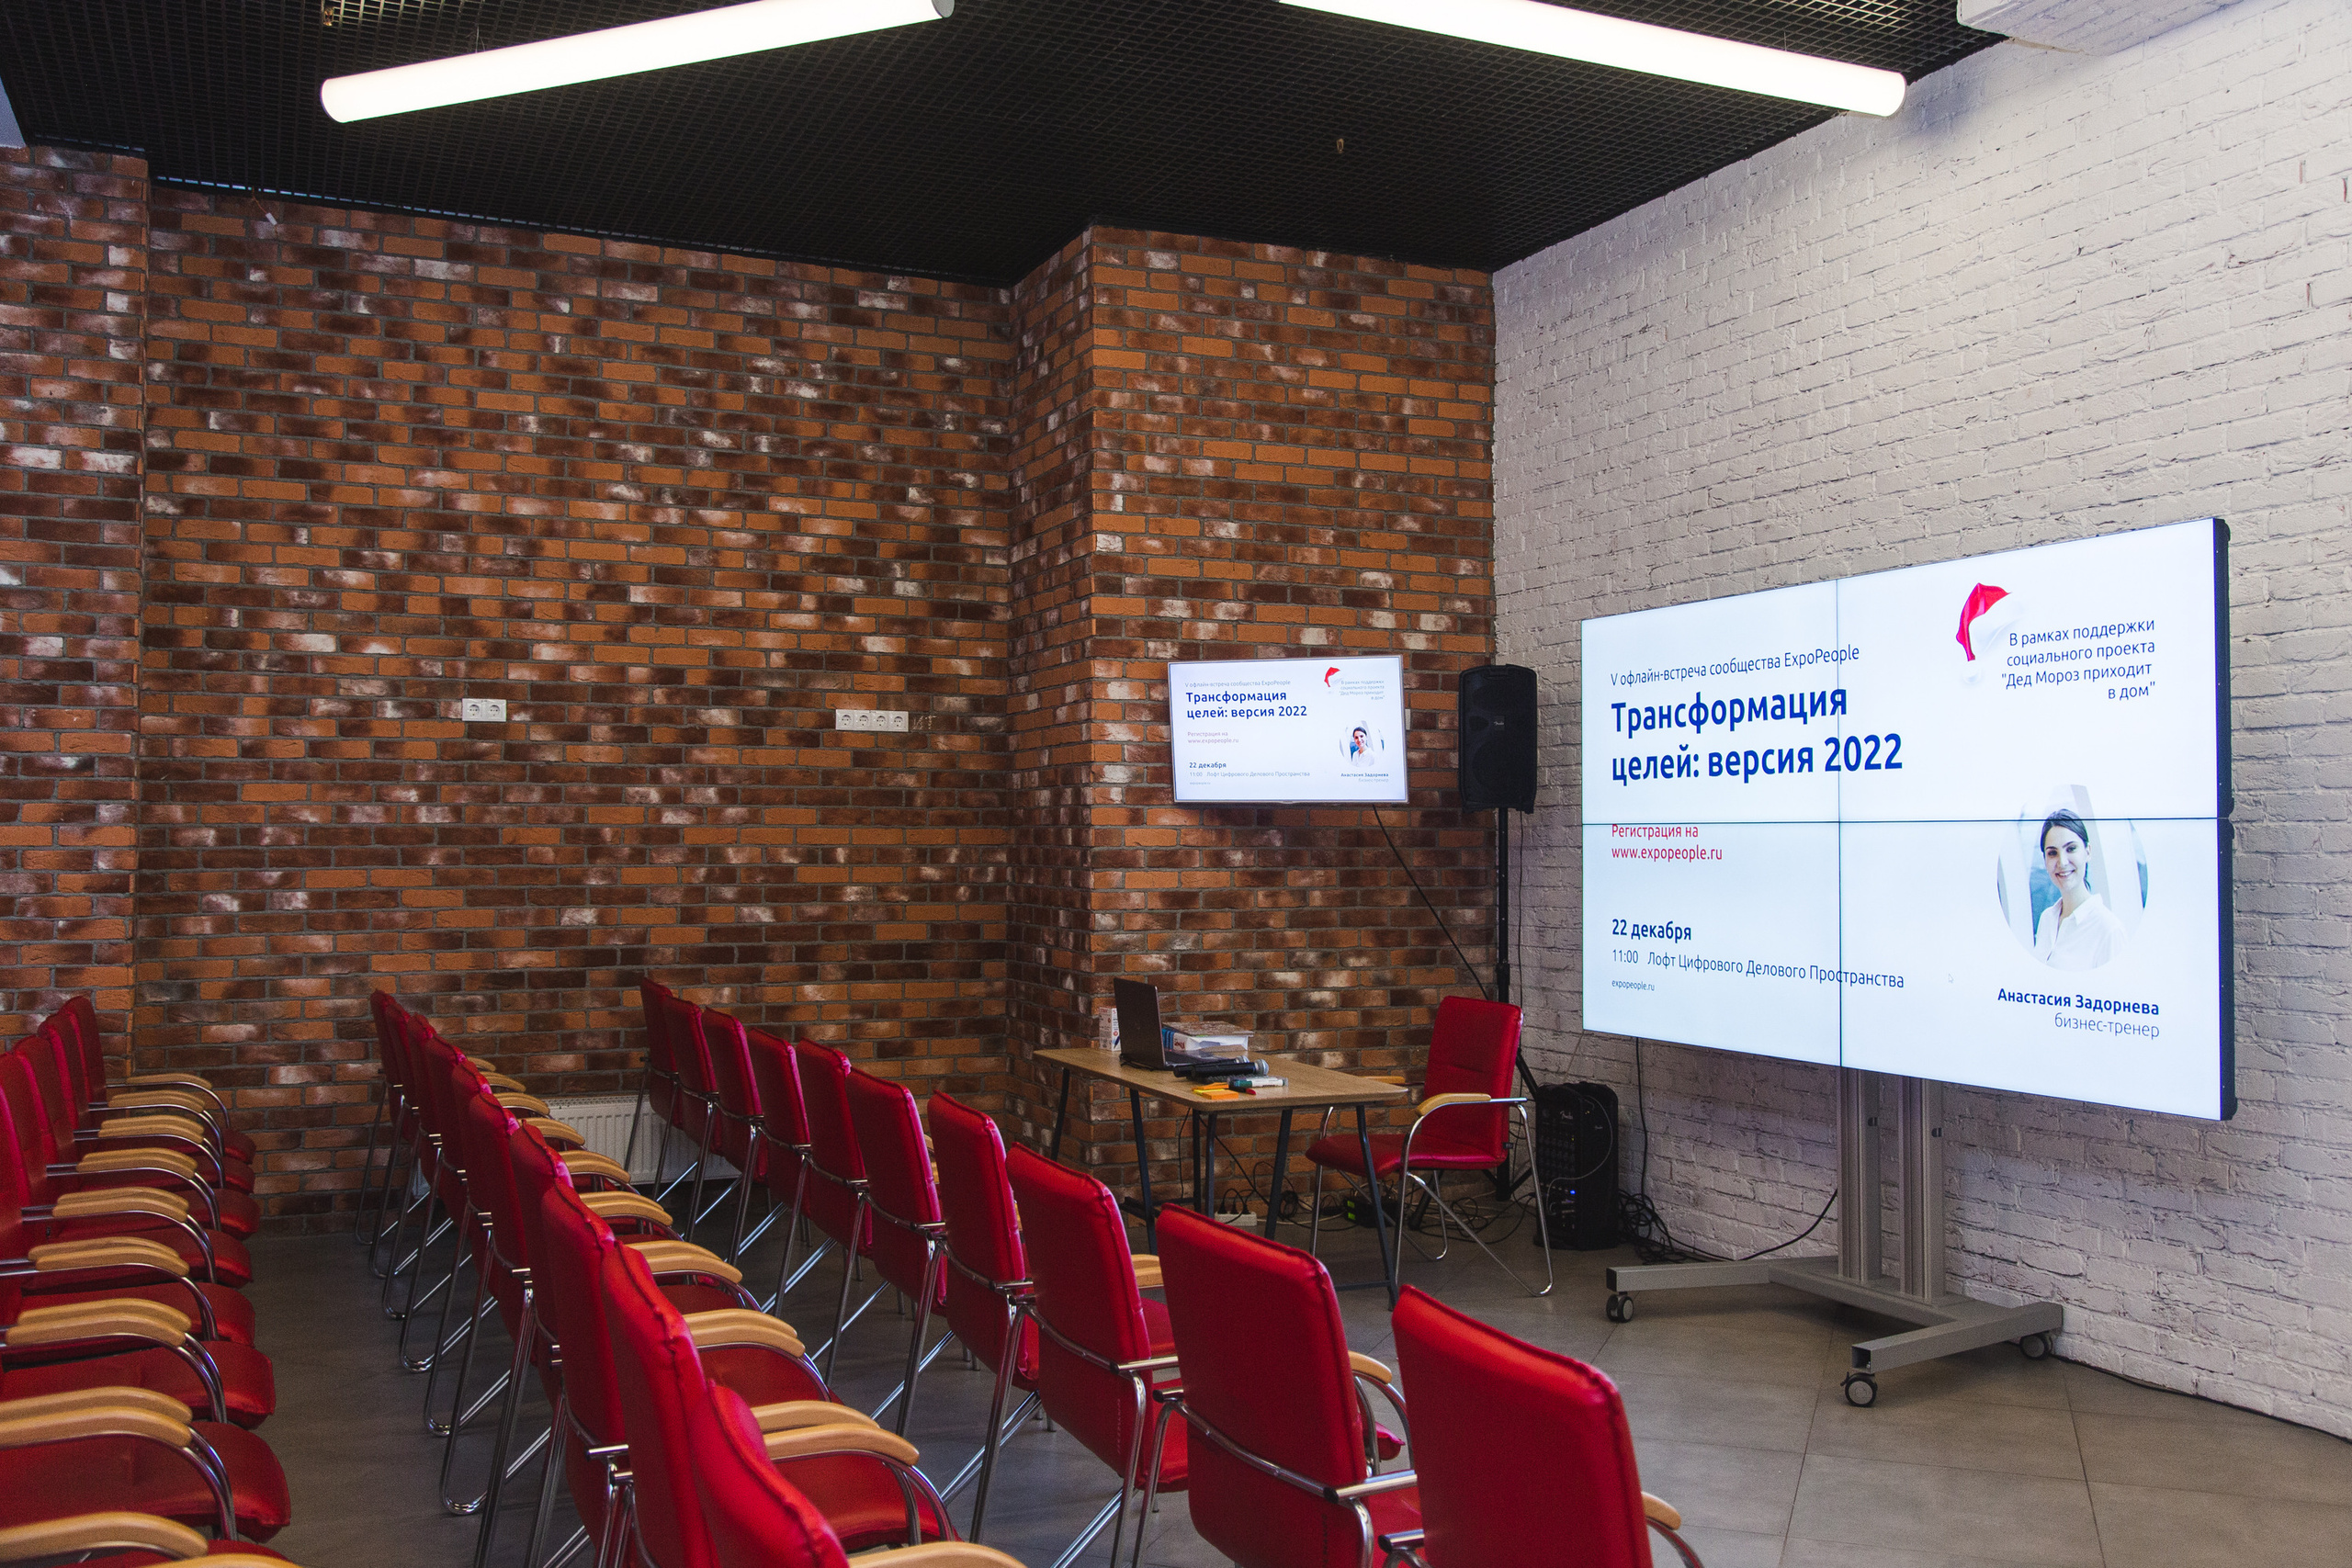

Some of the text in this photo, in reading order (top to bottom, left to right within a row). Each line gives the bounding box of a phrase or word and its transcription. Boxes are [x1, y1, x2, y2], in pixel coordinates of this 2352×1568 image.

[2009, 619, 2155, 649] В рамках поддержки
[1611, 644, 1860, 687] V офлайн-встреча сообщества ExpoPeople
[2007, 641, 2155, 667] социального проекта
[2001, 662, 2153, 690] "Дед Мороз приходит
[1185, 690, 1287, 705] Трансформация
[2108, 682, 2156, 701] в дом"
[1187, 705, 1307, 720] целей: версия 2022
[1611, 688, 1848, 739] Трансформация
[1198, 761, 1227, 770] декабря
[1611, 733, 1903, 787] целей: версия 2022
[1611, 824, 1699, 841] Регистрация на
[1611, 844, 1724, 863] www.expopeople.ru
[1611, 919, 1692, 944] 22 декабря
[1612, 949, 1905, 989] 11:00 Лофт Цифрового Делового Пространства
[1611, 977, 1656, 992] expopeople.ru
[1997, 987, 2160, 1016] Анастасия Задорнева
[2054, 1012, 2161, 1041] бизнес-тренер
